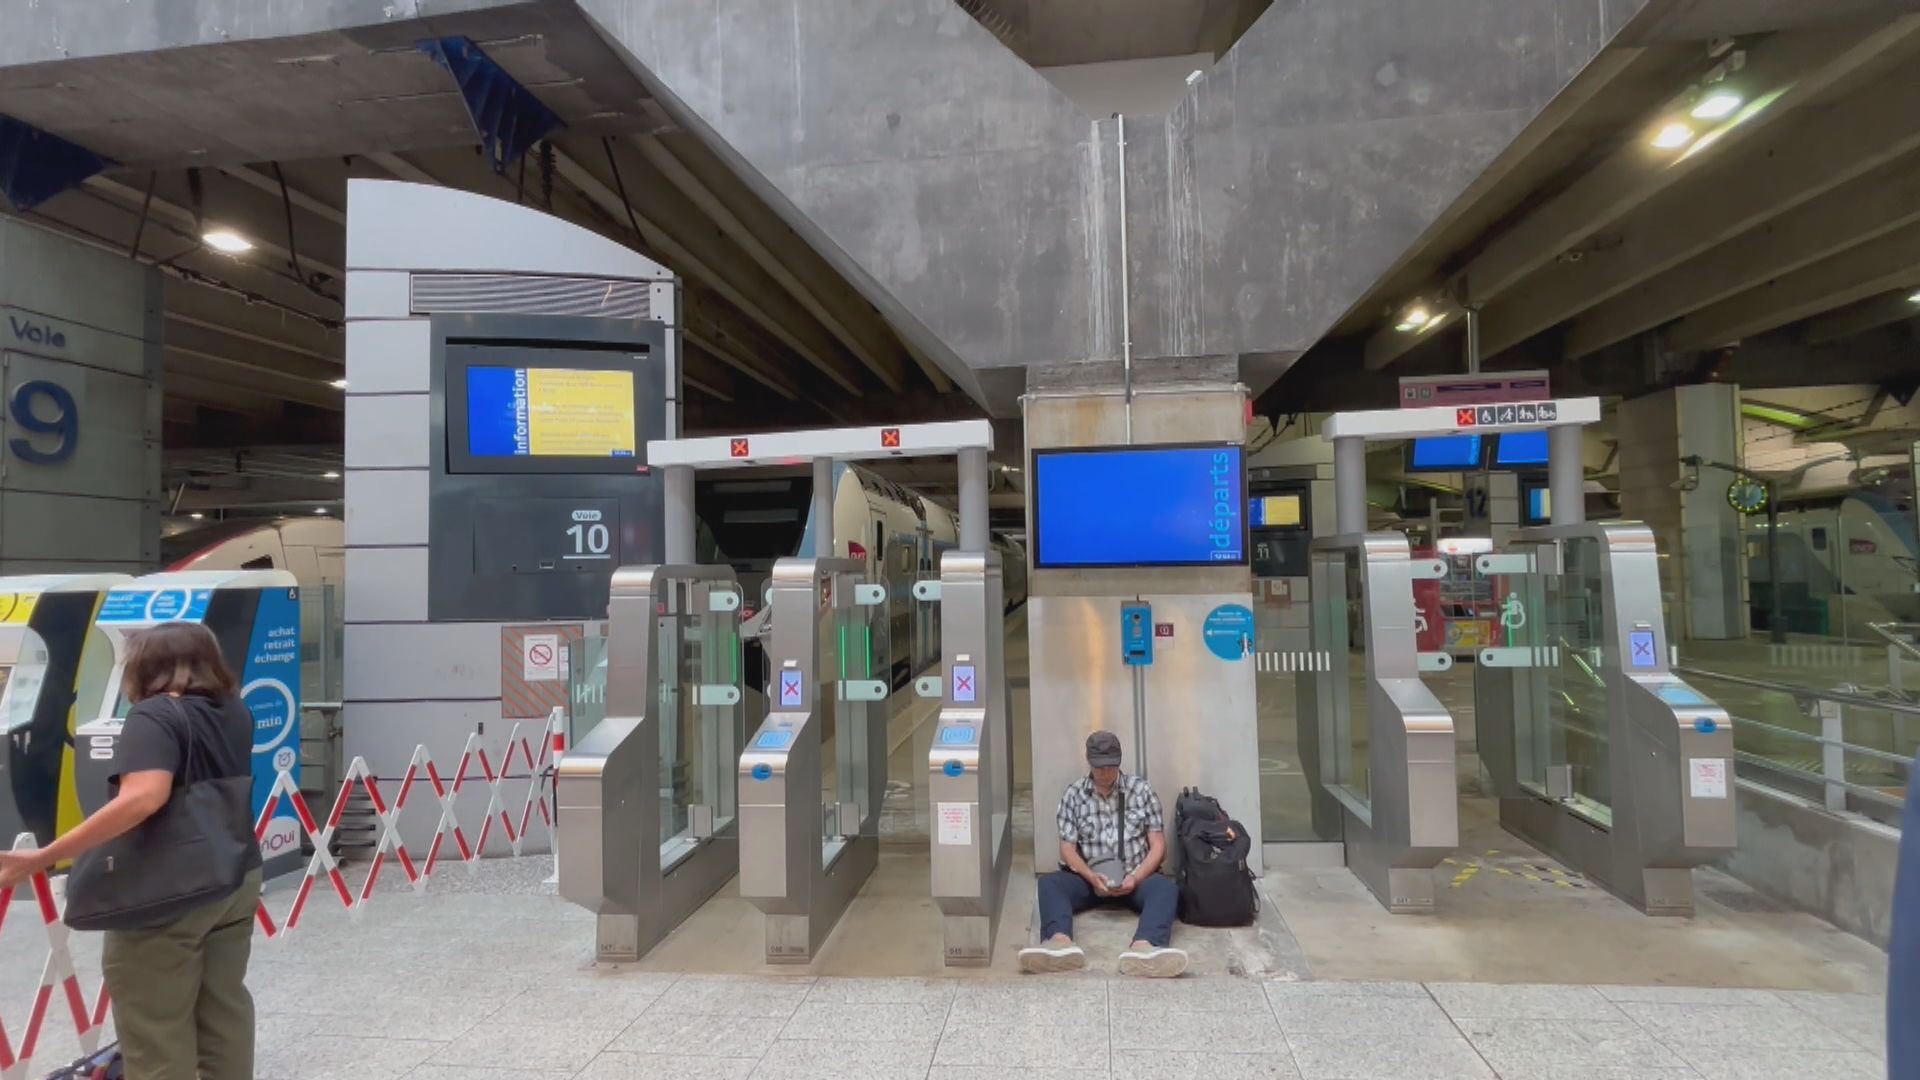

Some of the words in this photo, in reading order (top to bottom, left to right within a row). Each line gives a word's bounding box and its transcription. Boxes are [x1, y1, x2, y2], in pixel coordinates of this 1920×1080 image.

[9, 315, 67, 348] Voie
[9, 380, 79, 465] 9
[513, 368, 528, 455] information
[1209, 452, 1237, 549] départs
[575, 511, 599, 520] Voie
[566, 524, 609, 553] 10
[264, 638, 296, 650] retrait
[268, 626, 296, 638] achat
[254, 651, 296, 664] échange
[260, 830, 295, 851] nOui
